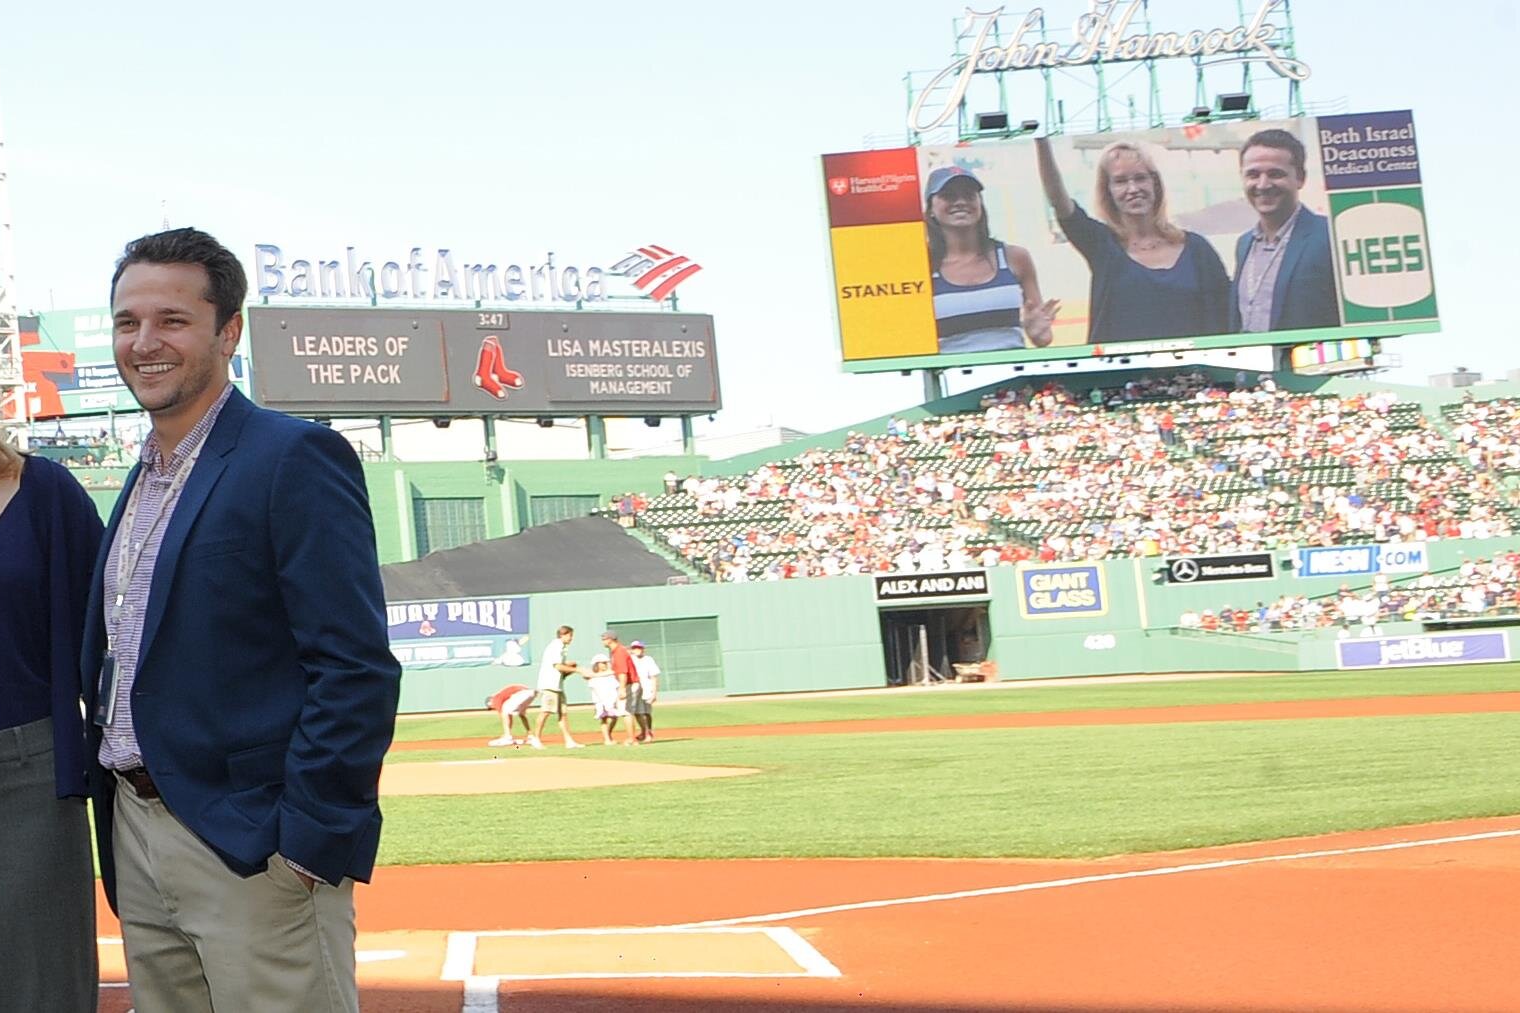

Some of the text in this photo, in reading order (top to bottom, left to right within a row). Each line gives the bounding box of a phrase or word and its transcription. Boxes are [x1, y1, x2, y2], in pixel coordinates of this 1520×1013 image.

[907, 0, 1310, 134] John Hancock
[1320, 123, 1414, 145] Beth Israel
[1323, 144, 1415, 162] Deaconess
[1324, 160, 1418, 175] Medical Center
[1342, 234, 1425, 276] HESS
[254, 244, 609, 302] Bank of America
[842, 280, 924, 299] STANLEY
[479, 314, 504, 326] 3:47
[292, 335, 409, 356] LEADERS OF
[547, 339, 706, 358] LISA MASTERALEXIS
[307, 364, 401, 384] THE PACK
[565, 363, 693, 378] ISENBERG SCHOOL OF
[590, 381, 673, 395] MANAGEMENT
[880, 576, 985, 596] ALEX AND ANI
[1029, 572, 1090, 592] GIANT
[1029, 590, 1096, 608] GLASS
[386, 600, 512, 632] WAY PARK
[1380, 639, 1464, 664] jetBlue
